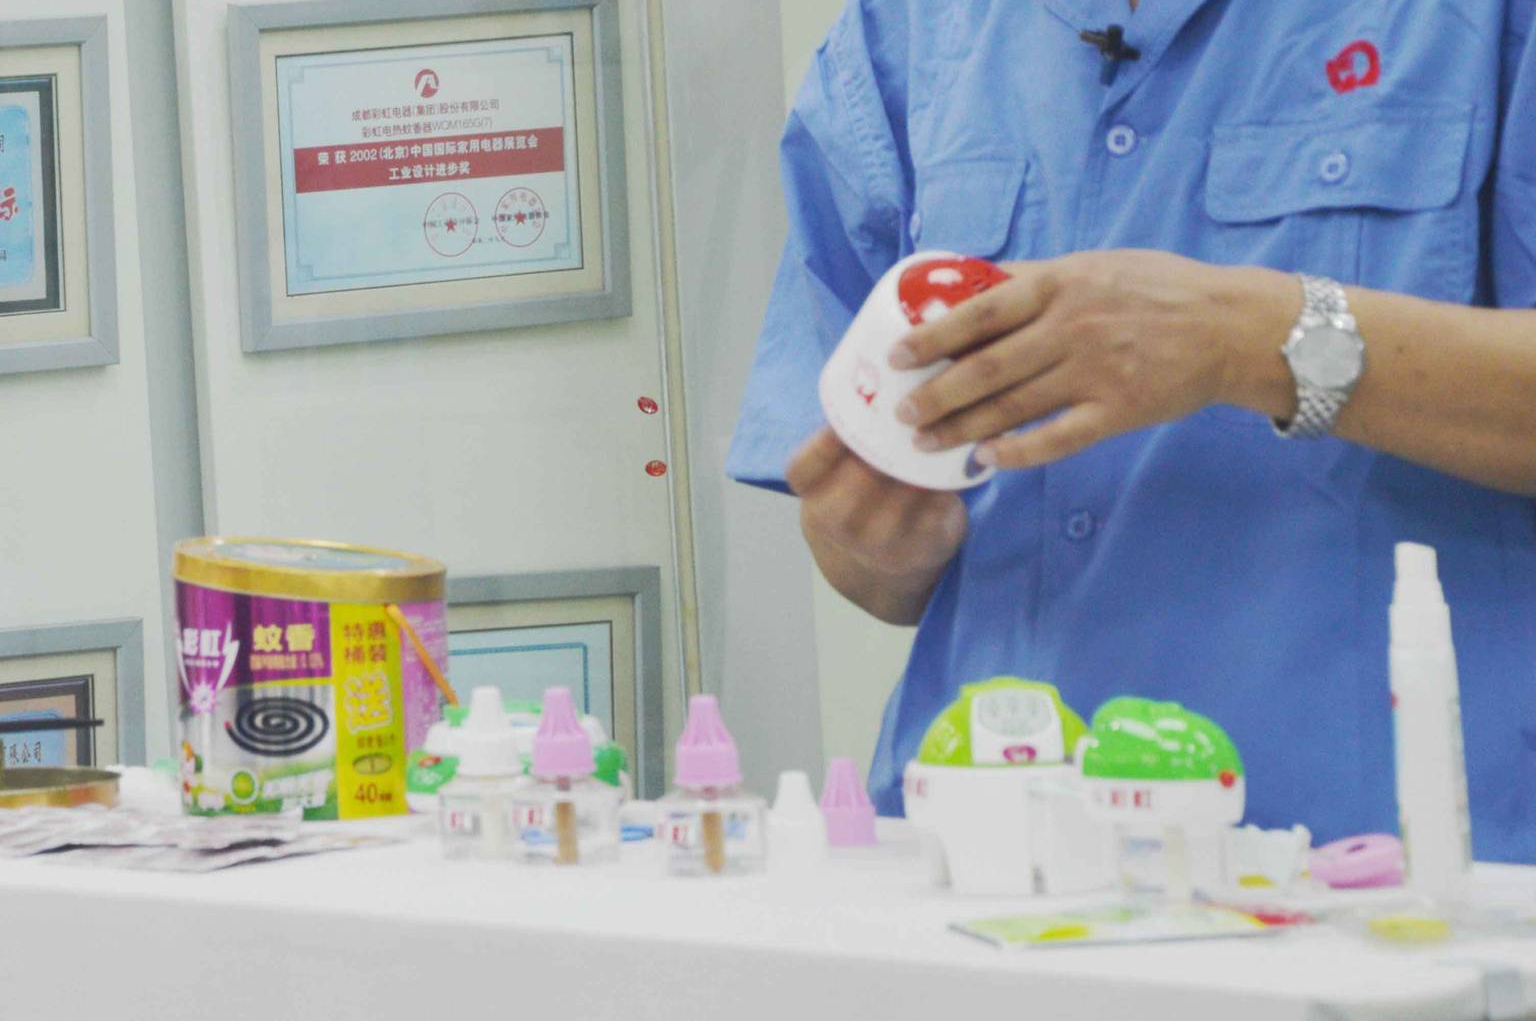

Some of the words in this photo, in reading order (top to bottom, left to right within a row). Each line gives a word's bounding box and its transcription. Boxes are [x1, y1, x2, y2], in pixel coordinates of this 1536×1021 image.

[388, 160, 471, 181] 工业设计进步奖
